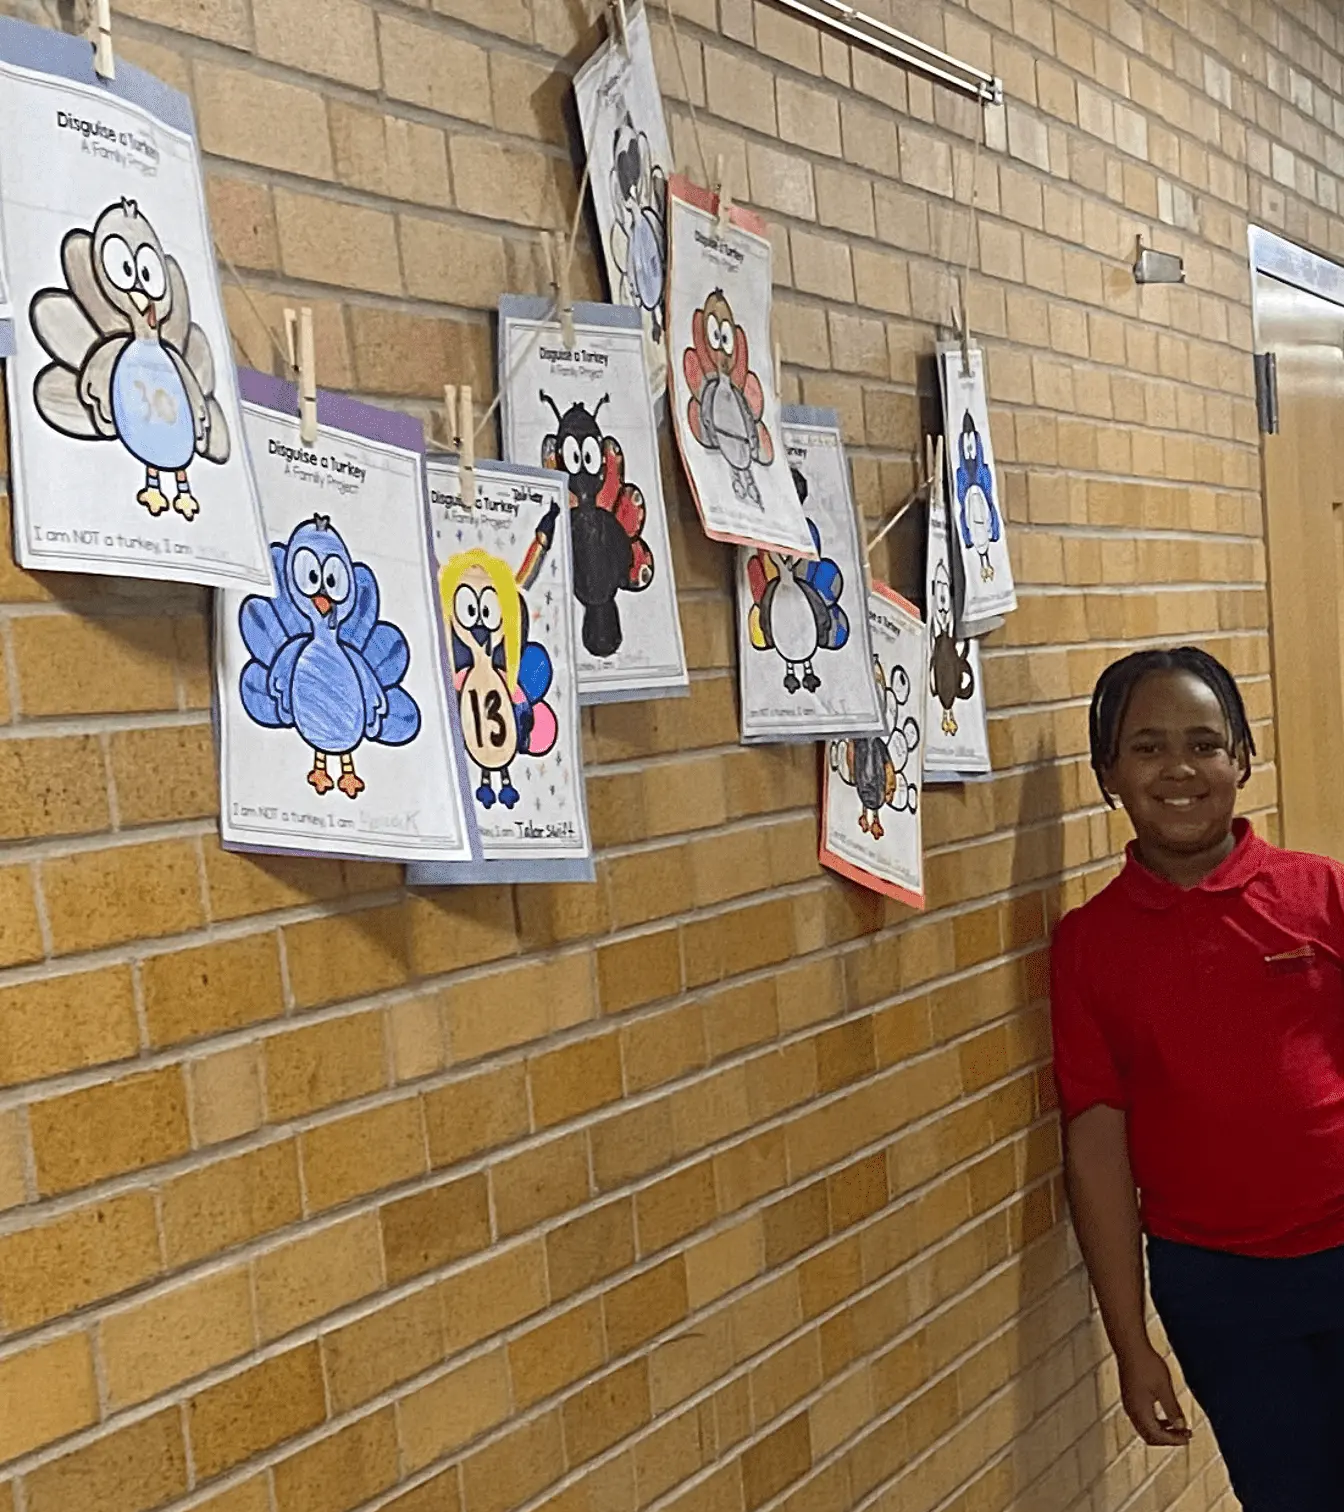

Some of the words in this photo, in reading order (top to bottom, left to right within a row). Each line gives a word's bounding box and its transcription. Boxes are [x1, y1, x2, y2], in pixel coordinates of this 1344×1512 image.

[57, 111, 117, 142] Disguise
[268, 438, 318, 467] Disguise
[320, 456, 328, 469] a
[330, 455, 367, 483] Turkey
[483, 496, 520, 518] Turkey
[34, 526, 42, 542] I
[46, 531, 69, 544] am
[73, 529, 100, 547] NOT
[104, 535, 113, 548] a
[163, 538, 171, 554] I
[174, 543, 193, 555] am
[467, 688, 508, 749] 13
